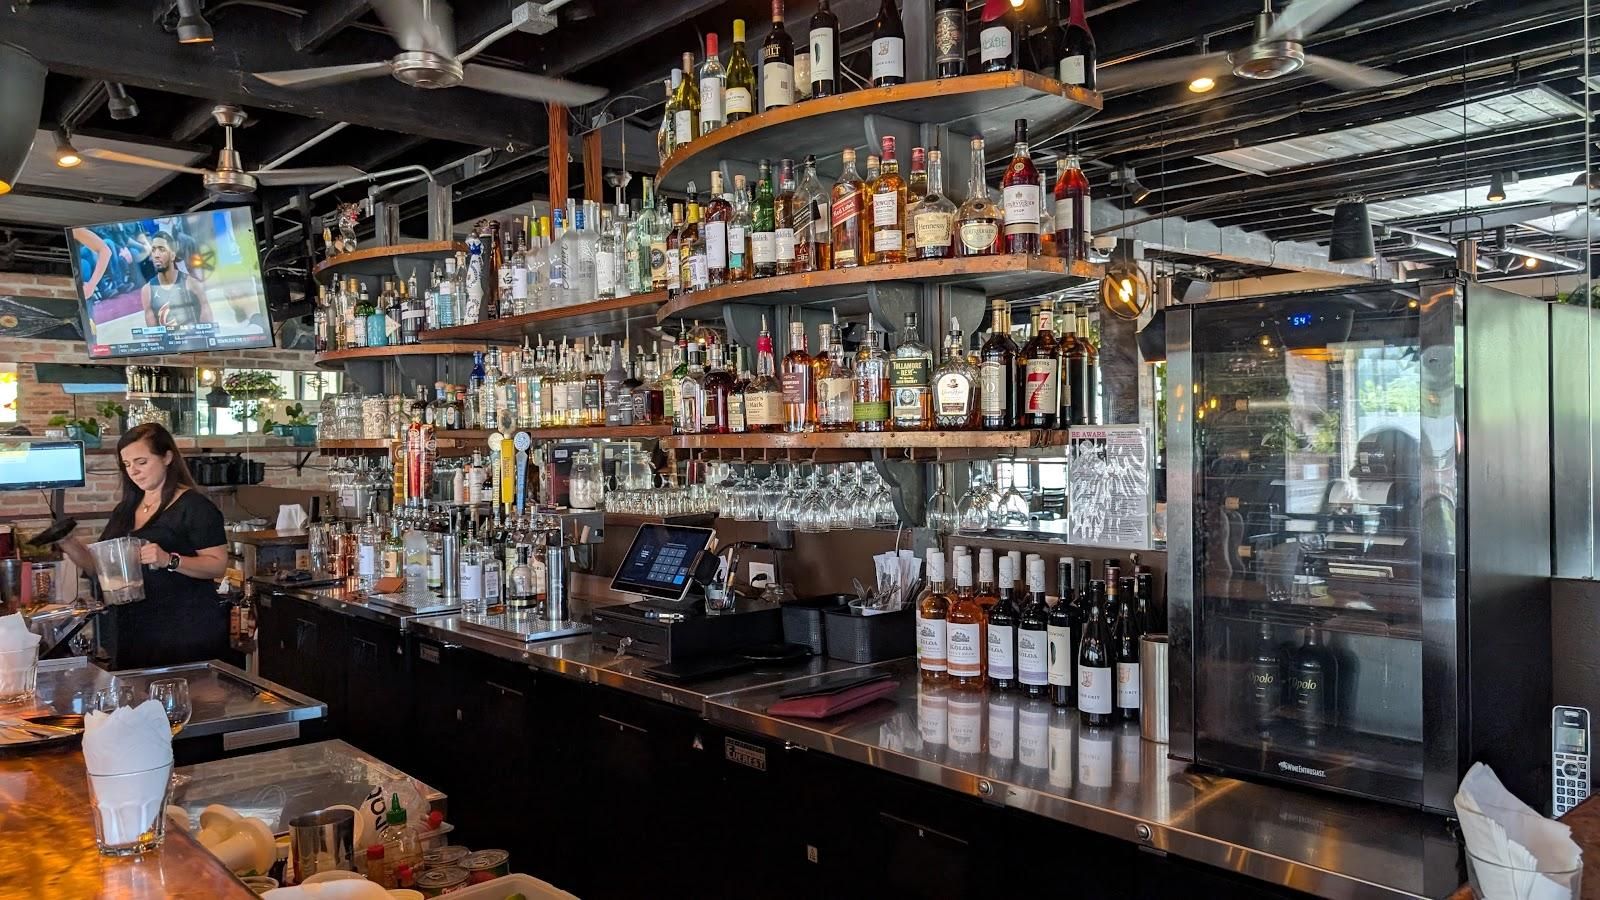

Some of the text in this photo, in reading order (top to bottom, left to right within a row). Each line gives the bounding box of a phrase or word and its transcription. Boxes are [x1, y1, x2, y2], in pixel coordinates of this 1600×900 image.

[833, 202, 855, 217] Red Label
[918, 222, 946, 231] Hennessy
[1041, 317, 1049, 329] 7
[1294, 316, 1306, 326] 54
[893, 361, 923, 370] TULLAMORE
[1027, 372, 1051, 411] 7
